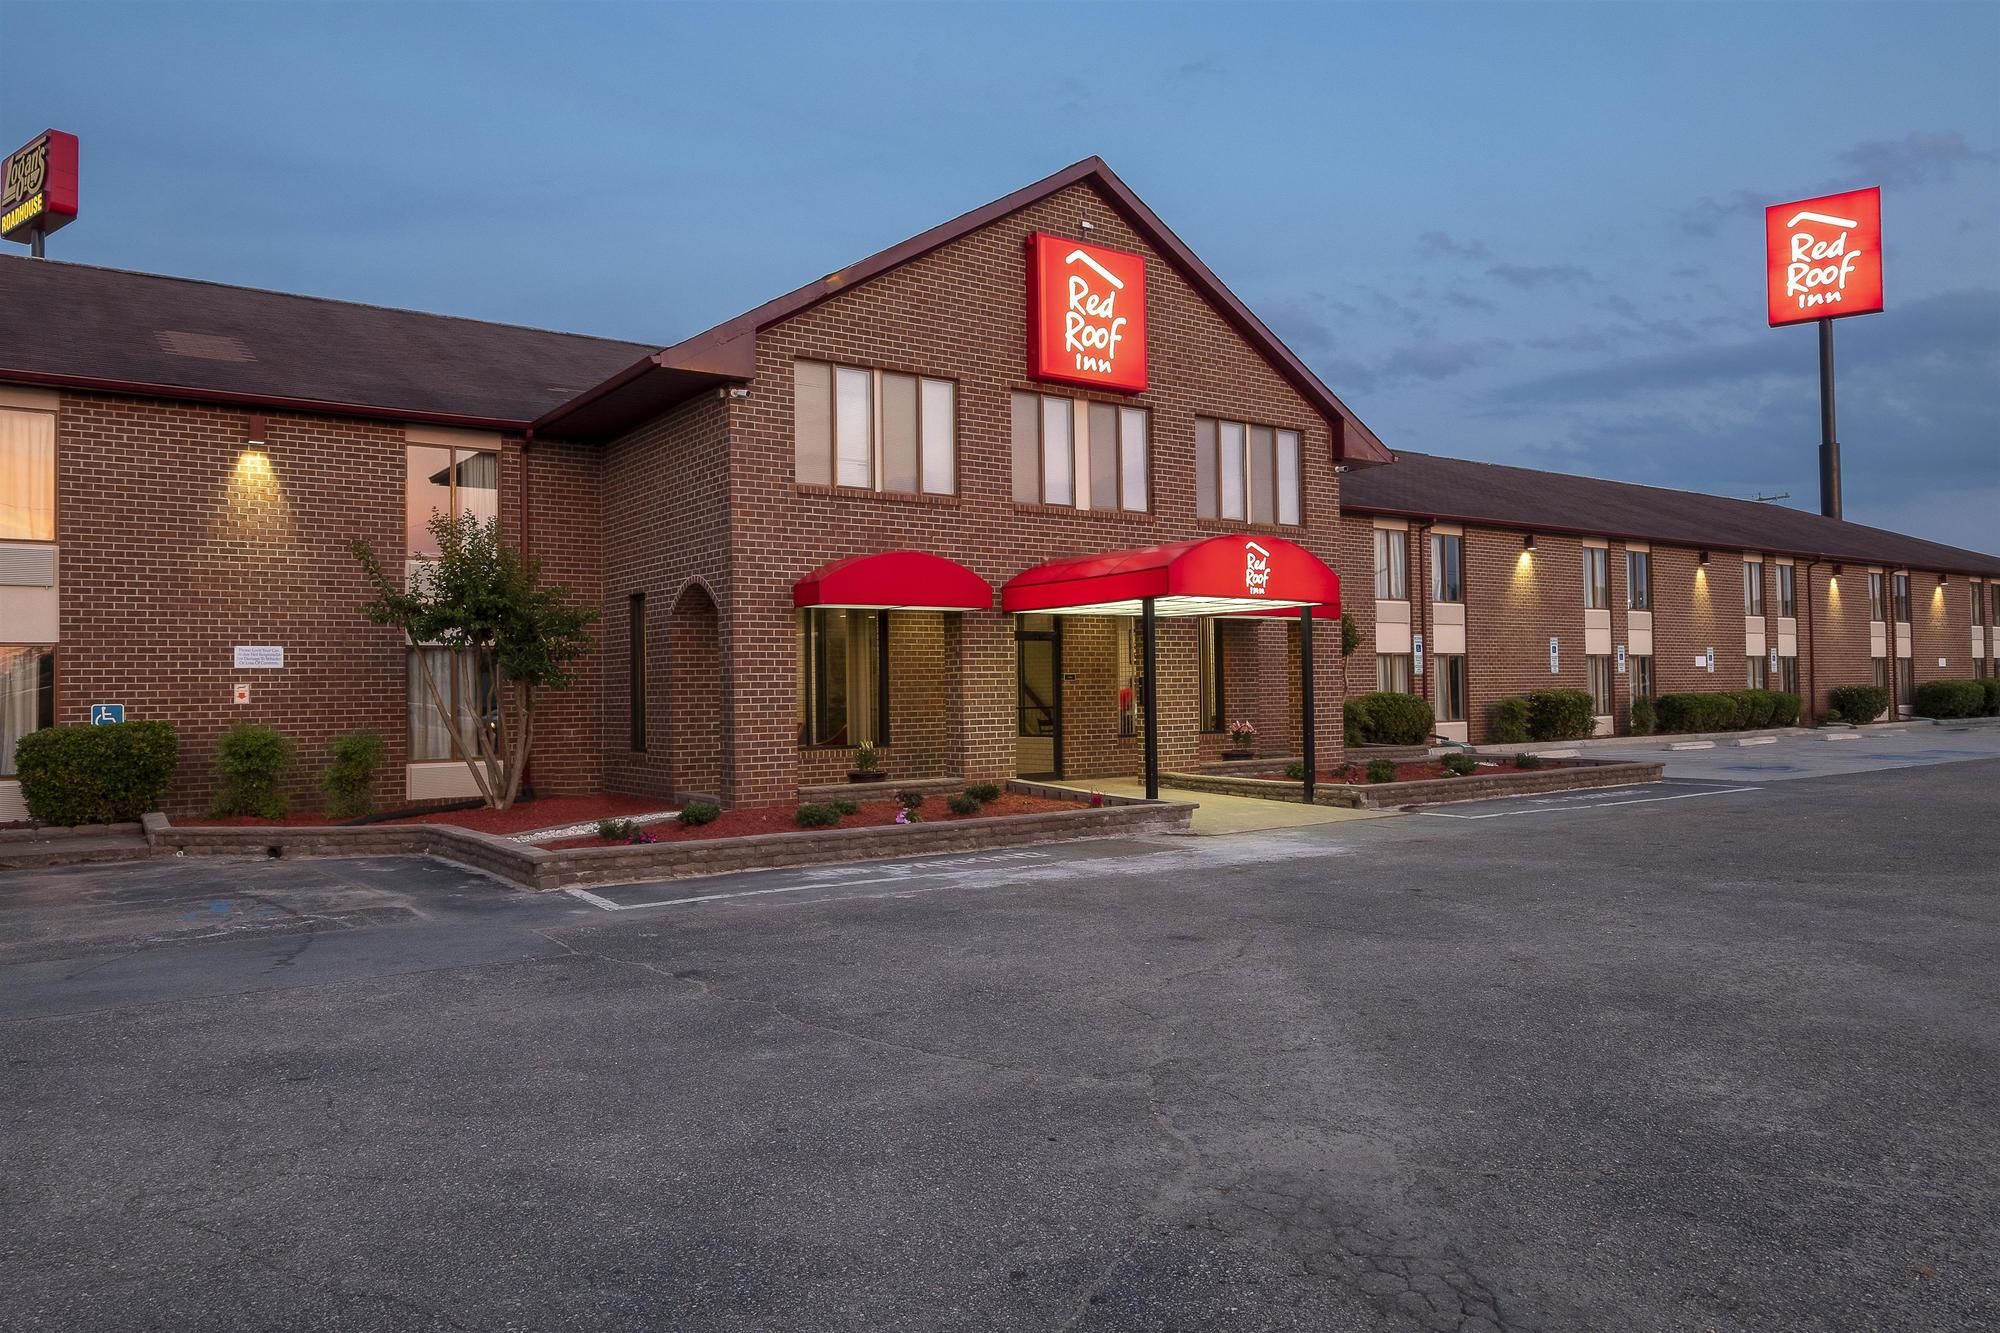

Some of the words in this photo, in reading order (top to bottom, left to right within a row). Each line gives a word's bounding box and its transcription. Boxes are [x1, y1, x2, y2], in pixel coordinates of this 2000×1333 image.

[2, 193, 43, 233] ROADHOUSE
[1791, 231, 1848, 262] Red
[1786, 250, 1861, 297] Roof
[1068, 275, 1116, 318] Red
[1065, 311, 1127, 359] Roof
[1245, 568, 1271, 588] Roof
[1246, 552, 1267, 570] Red
